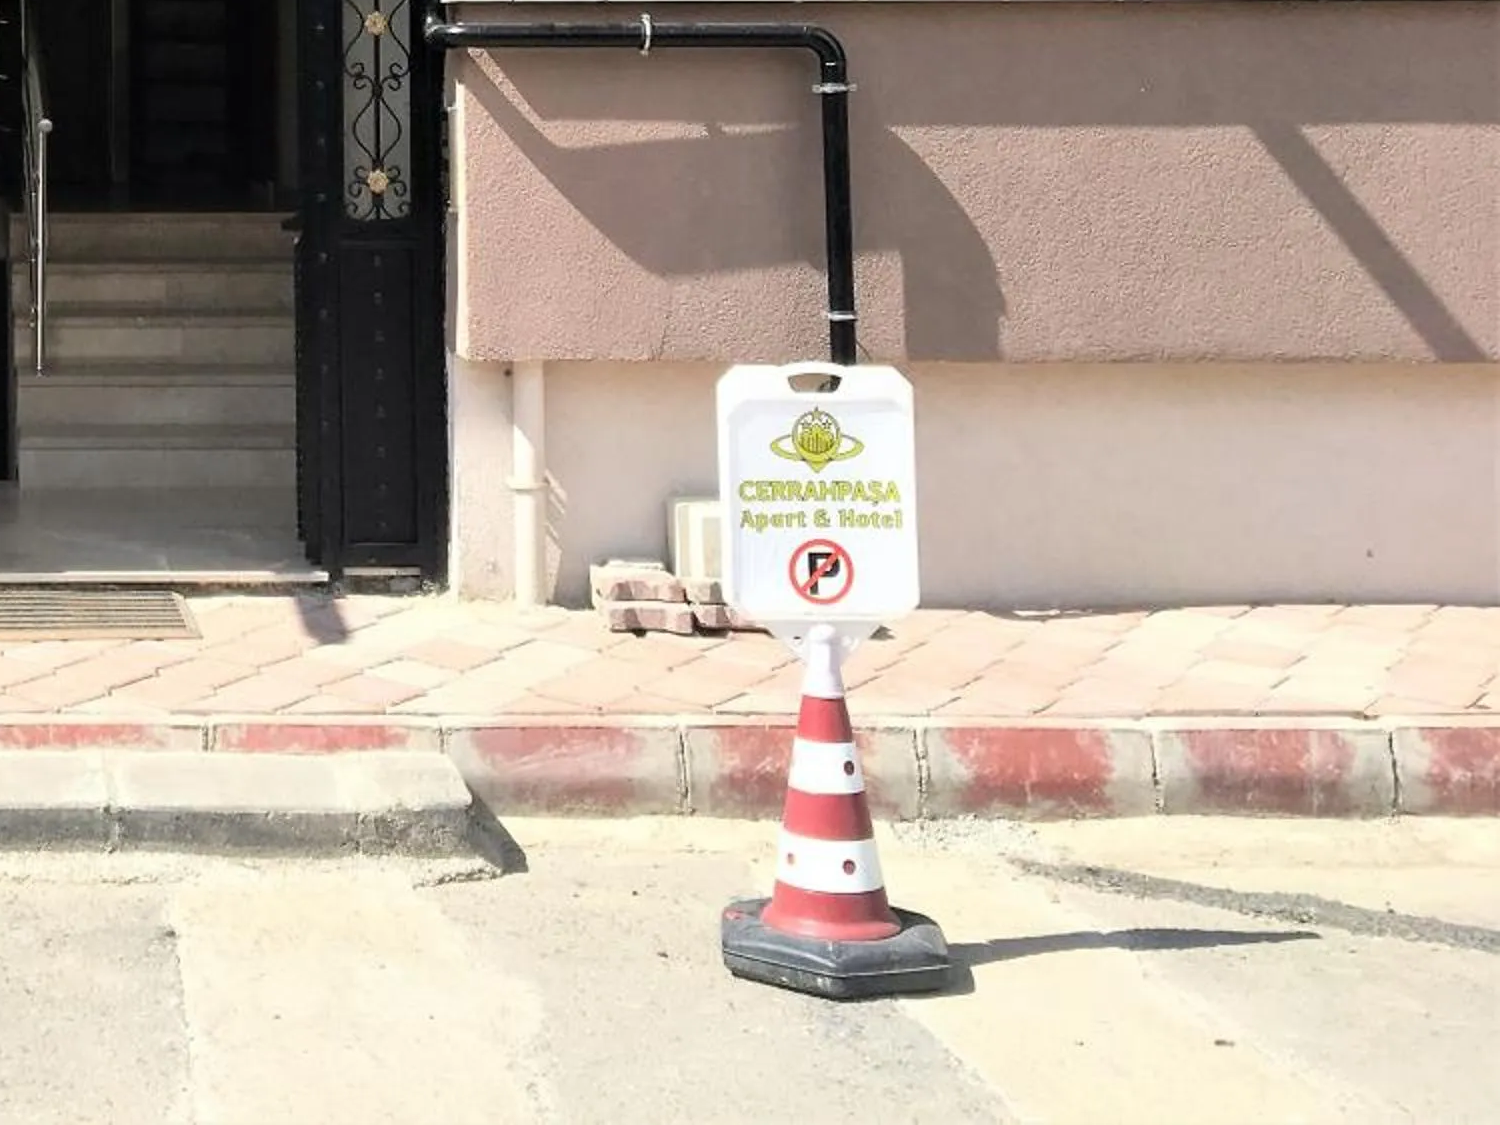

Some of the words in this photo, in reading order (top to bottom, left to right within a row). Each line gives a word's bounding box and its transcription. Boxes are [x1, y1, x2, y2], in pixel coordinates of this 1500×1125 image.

[739, 480, 901, 506] CERRAHPAŞA
[740, 509, 806, 533] Apart
[813, 508, 831, 528] &
[838, 508, 903, 528] Hotel
[808, 552, 841, 595] P
